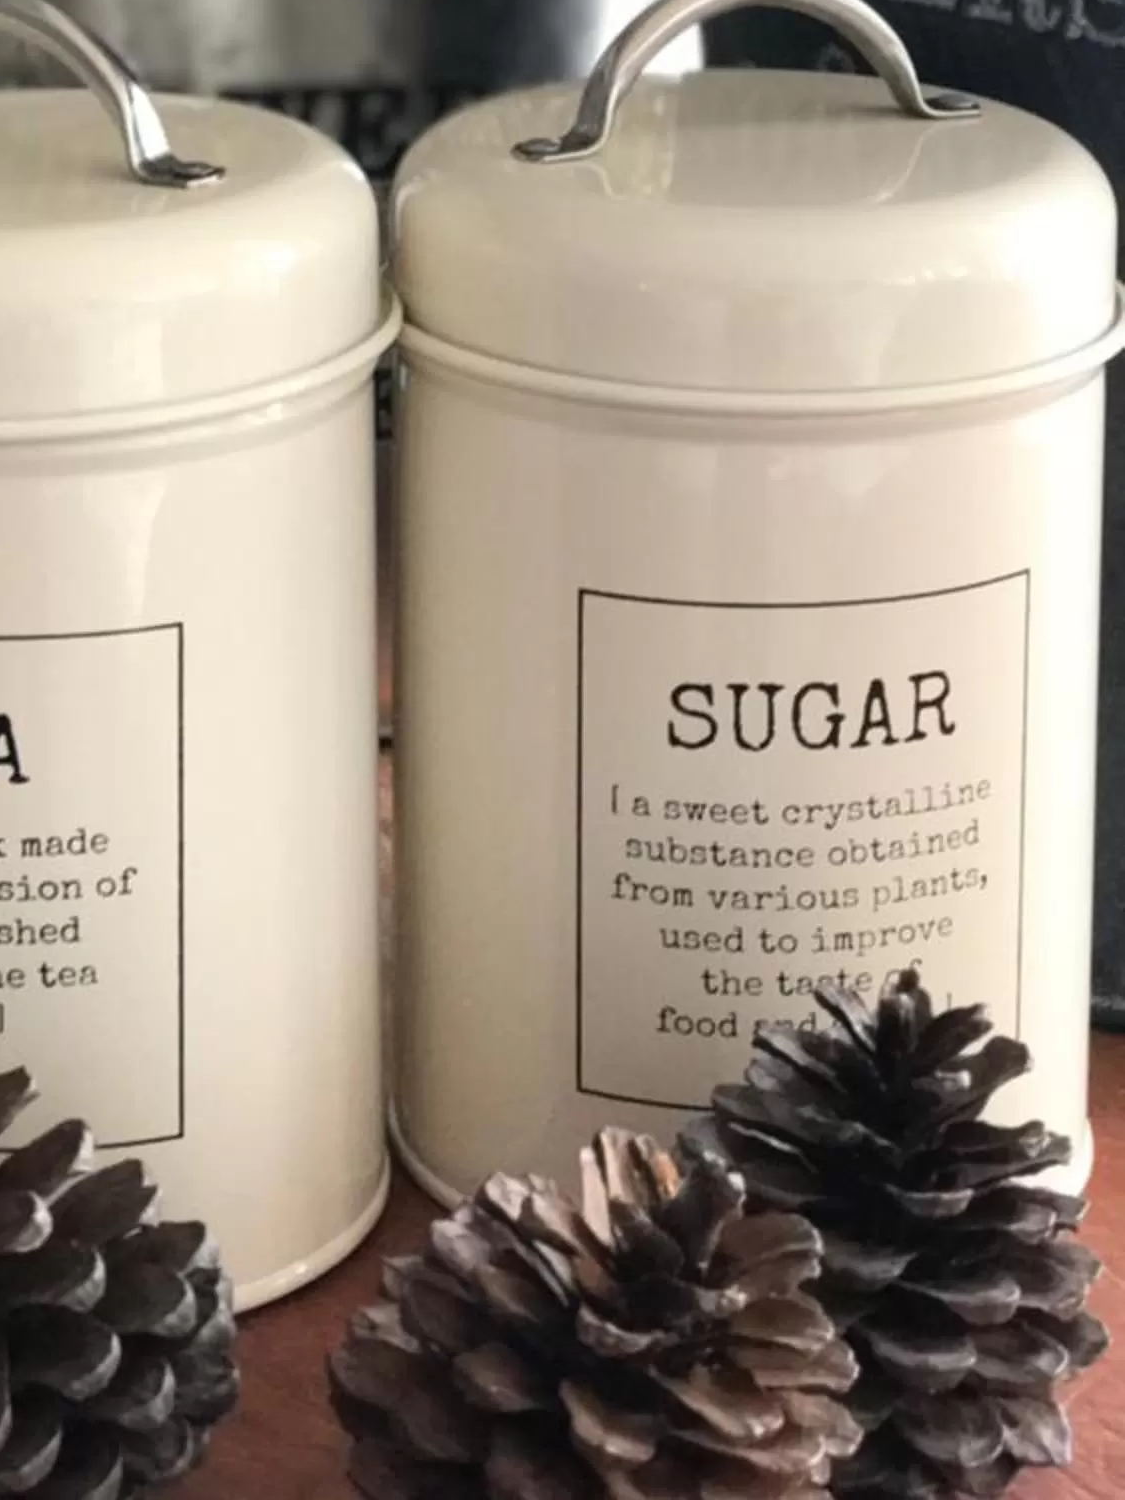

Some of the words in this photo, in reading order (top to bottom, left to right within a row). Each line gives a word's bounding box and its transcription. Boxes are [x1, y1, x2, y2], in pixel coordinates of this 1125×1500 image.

[667, 670, 956, 752] SUGAR
[664, 798, 770, 825] sweet
[781, 778, 991, 830] crystalline
[20, 827, 109, 858] made
[626, 836, 815, 868] substance
[828, 818, 979, 866] obtained
[96, 866, 138, 897] of
[611, 872, 694, 907] from
[708, 884, 859, 911] various
[873, 867, 988, 912] plants,
[659, 926, 743, 953] used
[759, 927, 798, 954] to
[811, 916, 954, 956] improve
[37, 962, 98, 988] tea
[701, 969, 763, 996] the
[657, 1005, 737, 1038] food
